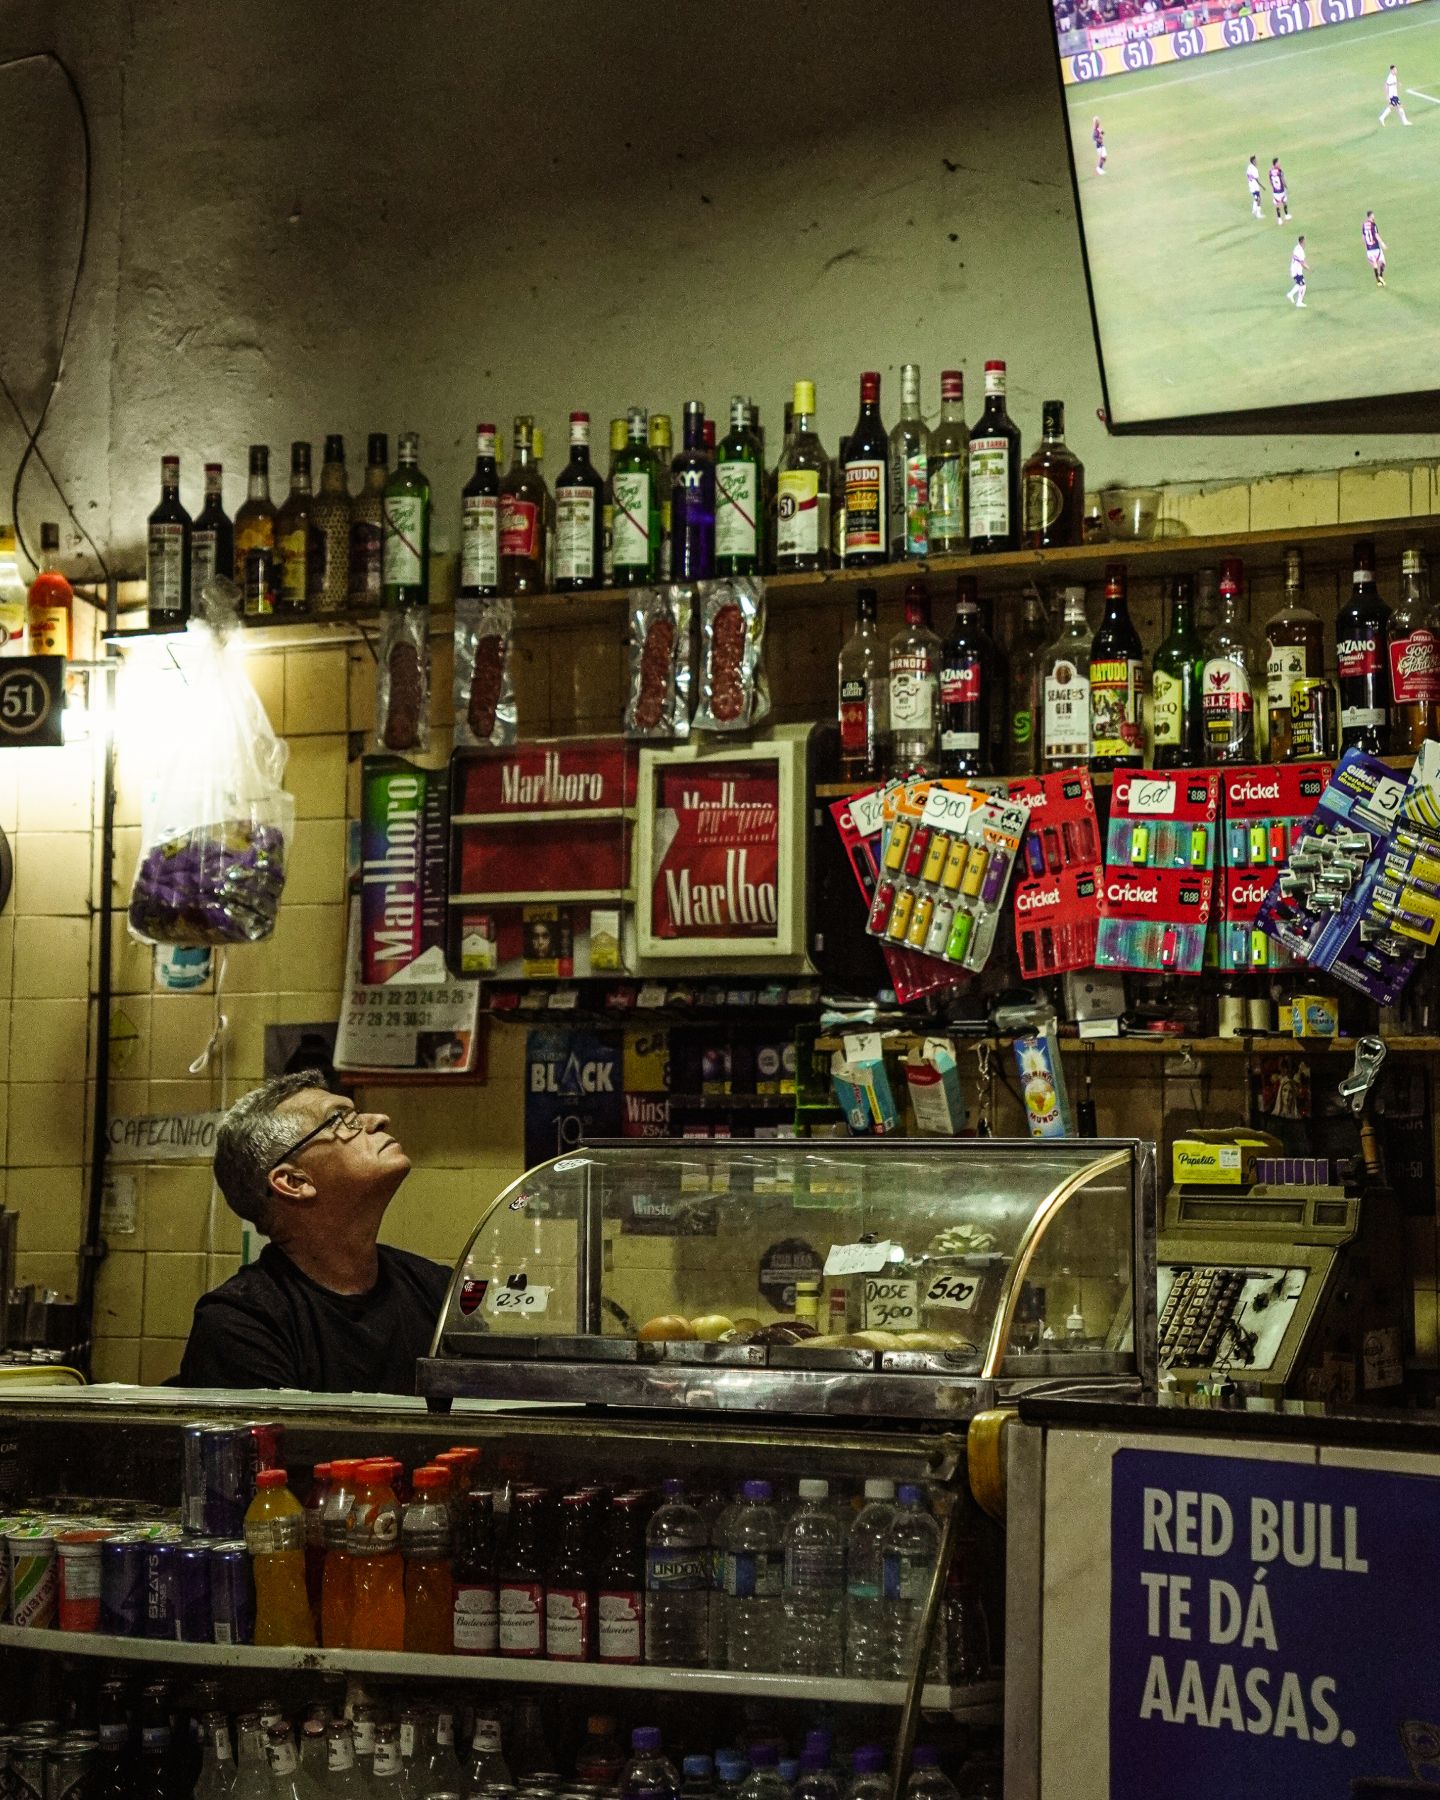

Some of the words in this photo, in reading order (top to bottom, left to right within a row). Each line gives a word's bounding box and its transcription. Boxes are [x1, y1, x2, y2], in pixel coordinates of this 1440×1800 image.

[1228, 17, 1249, 45] 51
[1276, 1, 1303, 35] 51
[1127, 42, 1150, 68] 51
[1177, 30, 1198, 57] 51
[1077, 54, 1100, 80] 51
[779, 497, 792, 517] 51
[2, 686, 36, 718] 51
[1055, 702, 1072, 715] GIN
[1291, 692, 1310, 719] 85
[501, 751, 604, 805] Marlboro
[1229, 781, 1280, 801] Cricket
[1303, 782, 1321, 794] 8.88
[1378, 786, 1400, 810] 5
[989, 832, 1016, 847] MAXI
[363, 777, 418, 962] Marlboro
[1017, 889, 1060, 911] Cricket
[1107, 883, 1159, 904] Cricket
[1231, 884, 1270, 903] Crick
[369, 991, 383, 1005] 21
[387, 991, 402, 1005] 22
[405, 991, 417, 1005] 23
[348, 1013, 364, 1026] 27
[367, 1013, 382, 1026] 28
[385, 1013, 400, 1026] 29
[403, 1012, 417, 1026] 30
[530, 1053, 614, 1096] BLACK
[625, 1094, 671, 1124] Winst
[1030, 1109, 1060, 1125] MUNDO
[109, 1118, 216, 1148] CAFEZINHO
[1177, 1152, 1216, 1167] Papelito
[865, 1281, 909, 1302] DOSE
[1142, 1486, 1234, 1558] RED
[1250, 1496, 1369, 1574] BULL
[14, 1566, 57, 1627] Guaran
[149, 1554, 159, 1619] BEATS
[456, 1615, 499, 1627] Budweiser
[1140, 1571, 1193, 1641] TE
[1208, 1566, 1279, 1651] DÁ
[1139, 1654, 1357, 1749] AAASAS.
